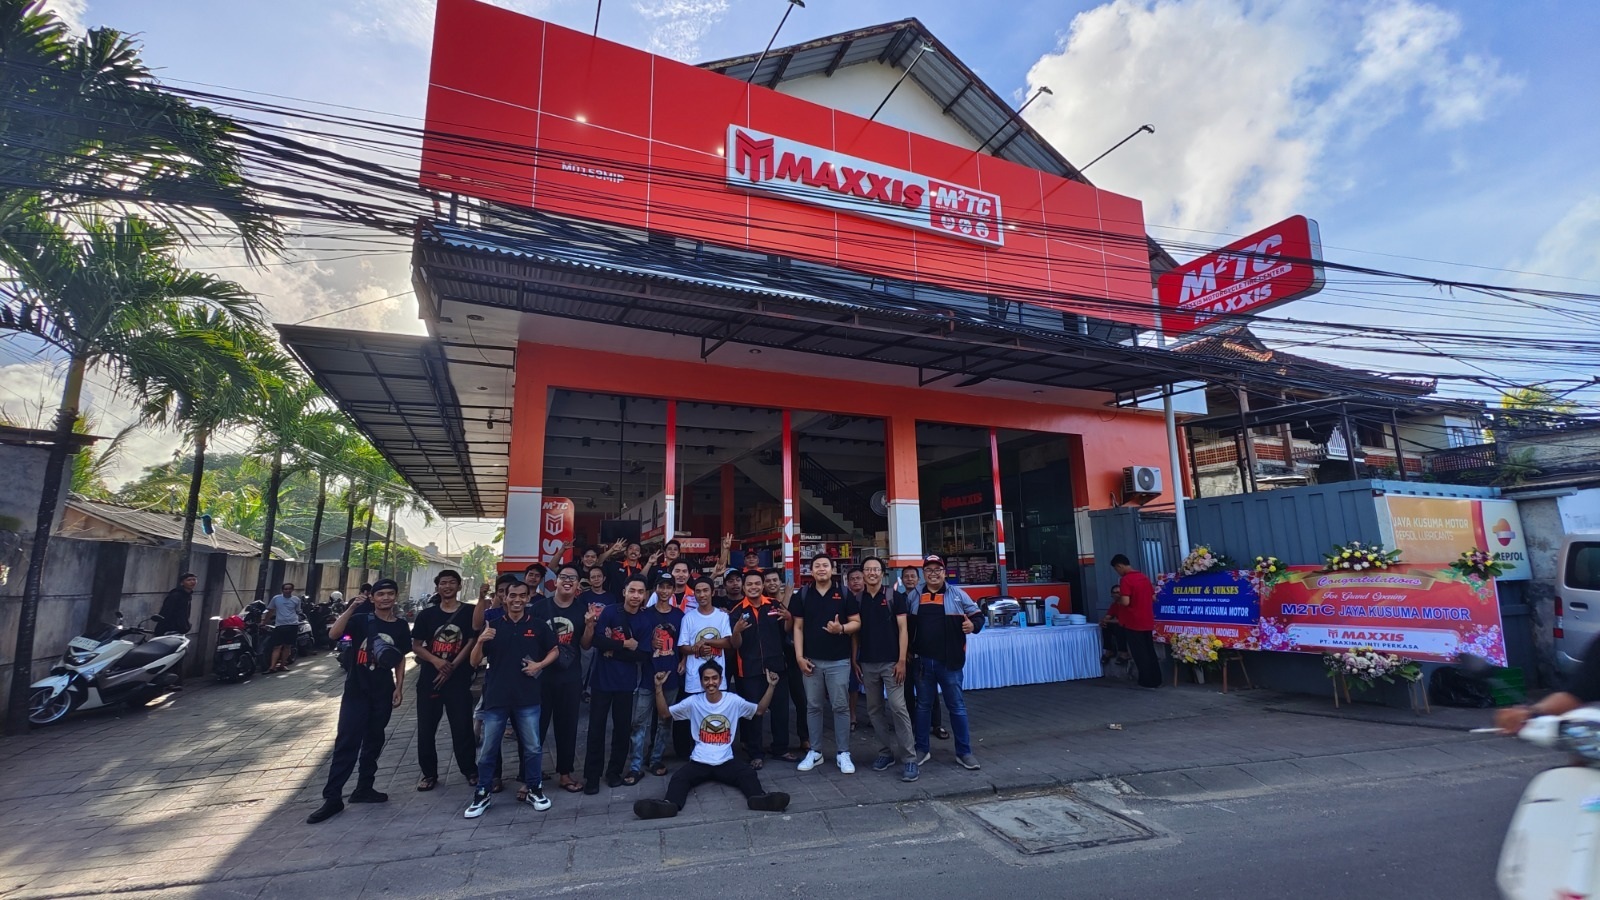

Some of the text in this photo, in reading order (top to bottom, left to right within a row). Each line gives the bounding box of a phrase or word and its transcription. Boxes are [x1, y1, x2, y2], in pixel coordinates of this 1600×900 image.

[775, 152, 925, 210] MAXXIS
[1203, 282, 1243, 303] MOTORCYCLE
[1194, 283, 1273, 325] MAXXIS
[1394, 517, 1469, 528] JAYA KUSUMA MOTOR
[1419, 530, 1454, 541] LUBRICANTS
[1317, 575, 1422, 587] Congratulations
[1173, 586, 1239, 595] SELAMAT & SUKSES
[1322, 592, 1408, 602] For Grand Opening
[1177, 605, 1191, 615] M2TC
[1191, 605, 1204, 615] JAYA
[1204, 606, 1228, 616] KUSUMA
[1228, 607, 1249, 617] MOTOR
[1281, 604, 1472, 621] M2TC JAYA KUSUMA MOTOR
[1341, 631, 1405, 642] MAXXIS
